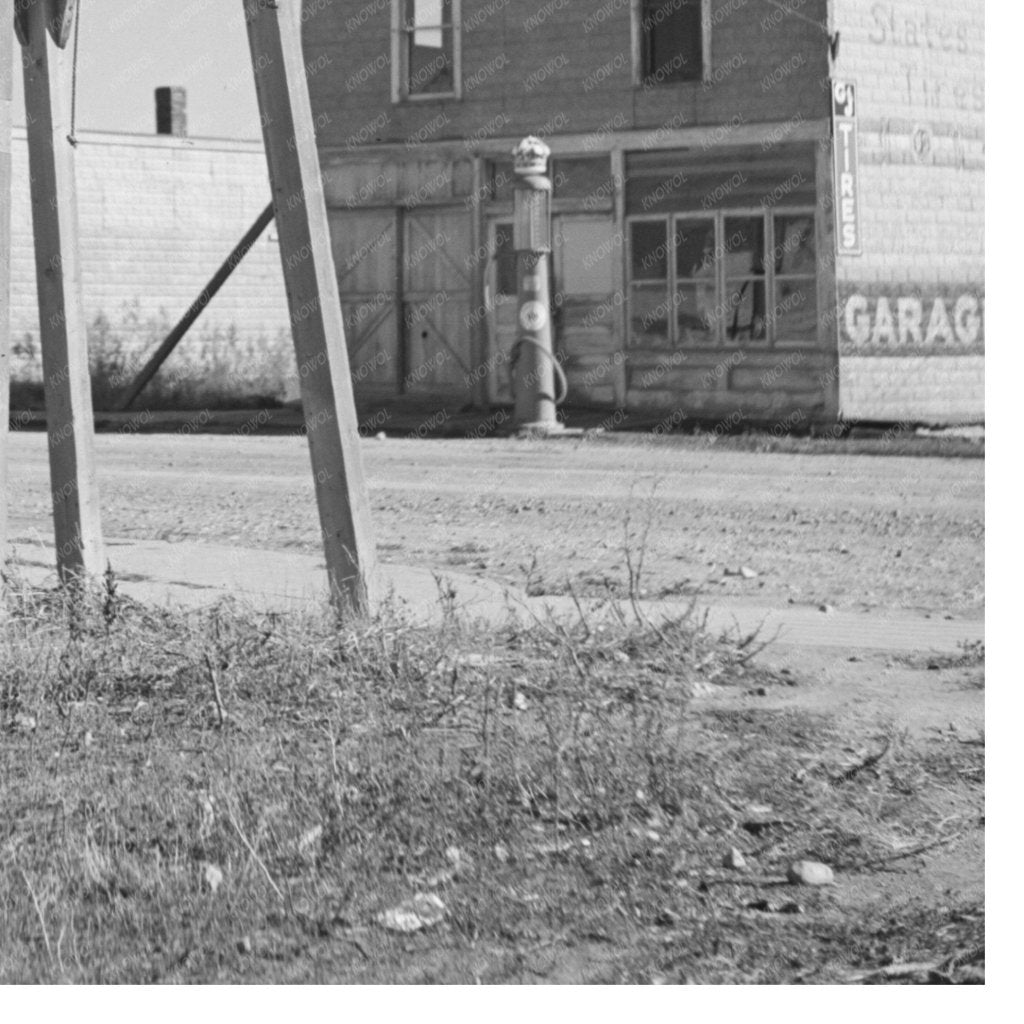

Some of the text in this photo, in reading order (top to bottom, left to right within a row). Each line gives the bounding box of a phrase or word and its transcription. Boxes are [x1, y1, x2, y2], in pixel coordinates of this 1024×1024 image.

[868, 2, 969, 54] States
[840, 123, 856, 248] TIRES
[845, 294, 984, 347] GARAG
